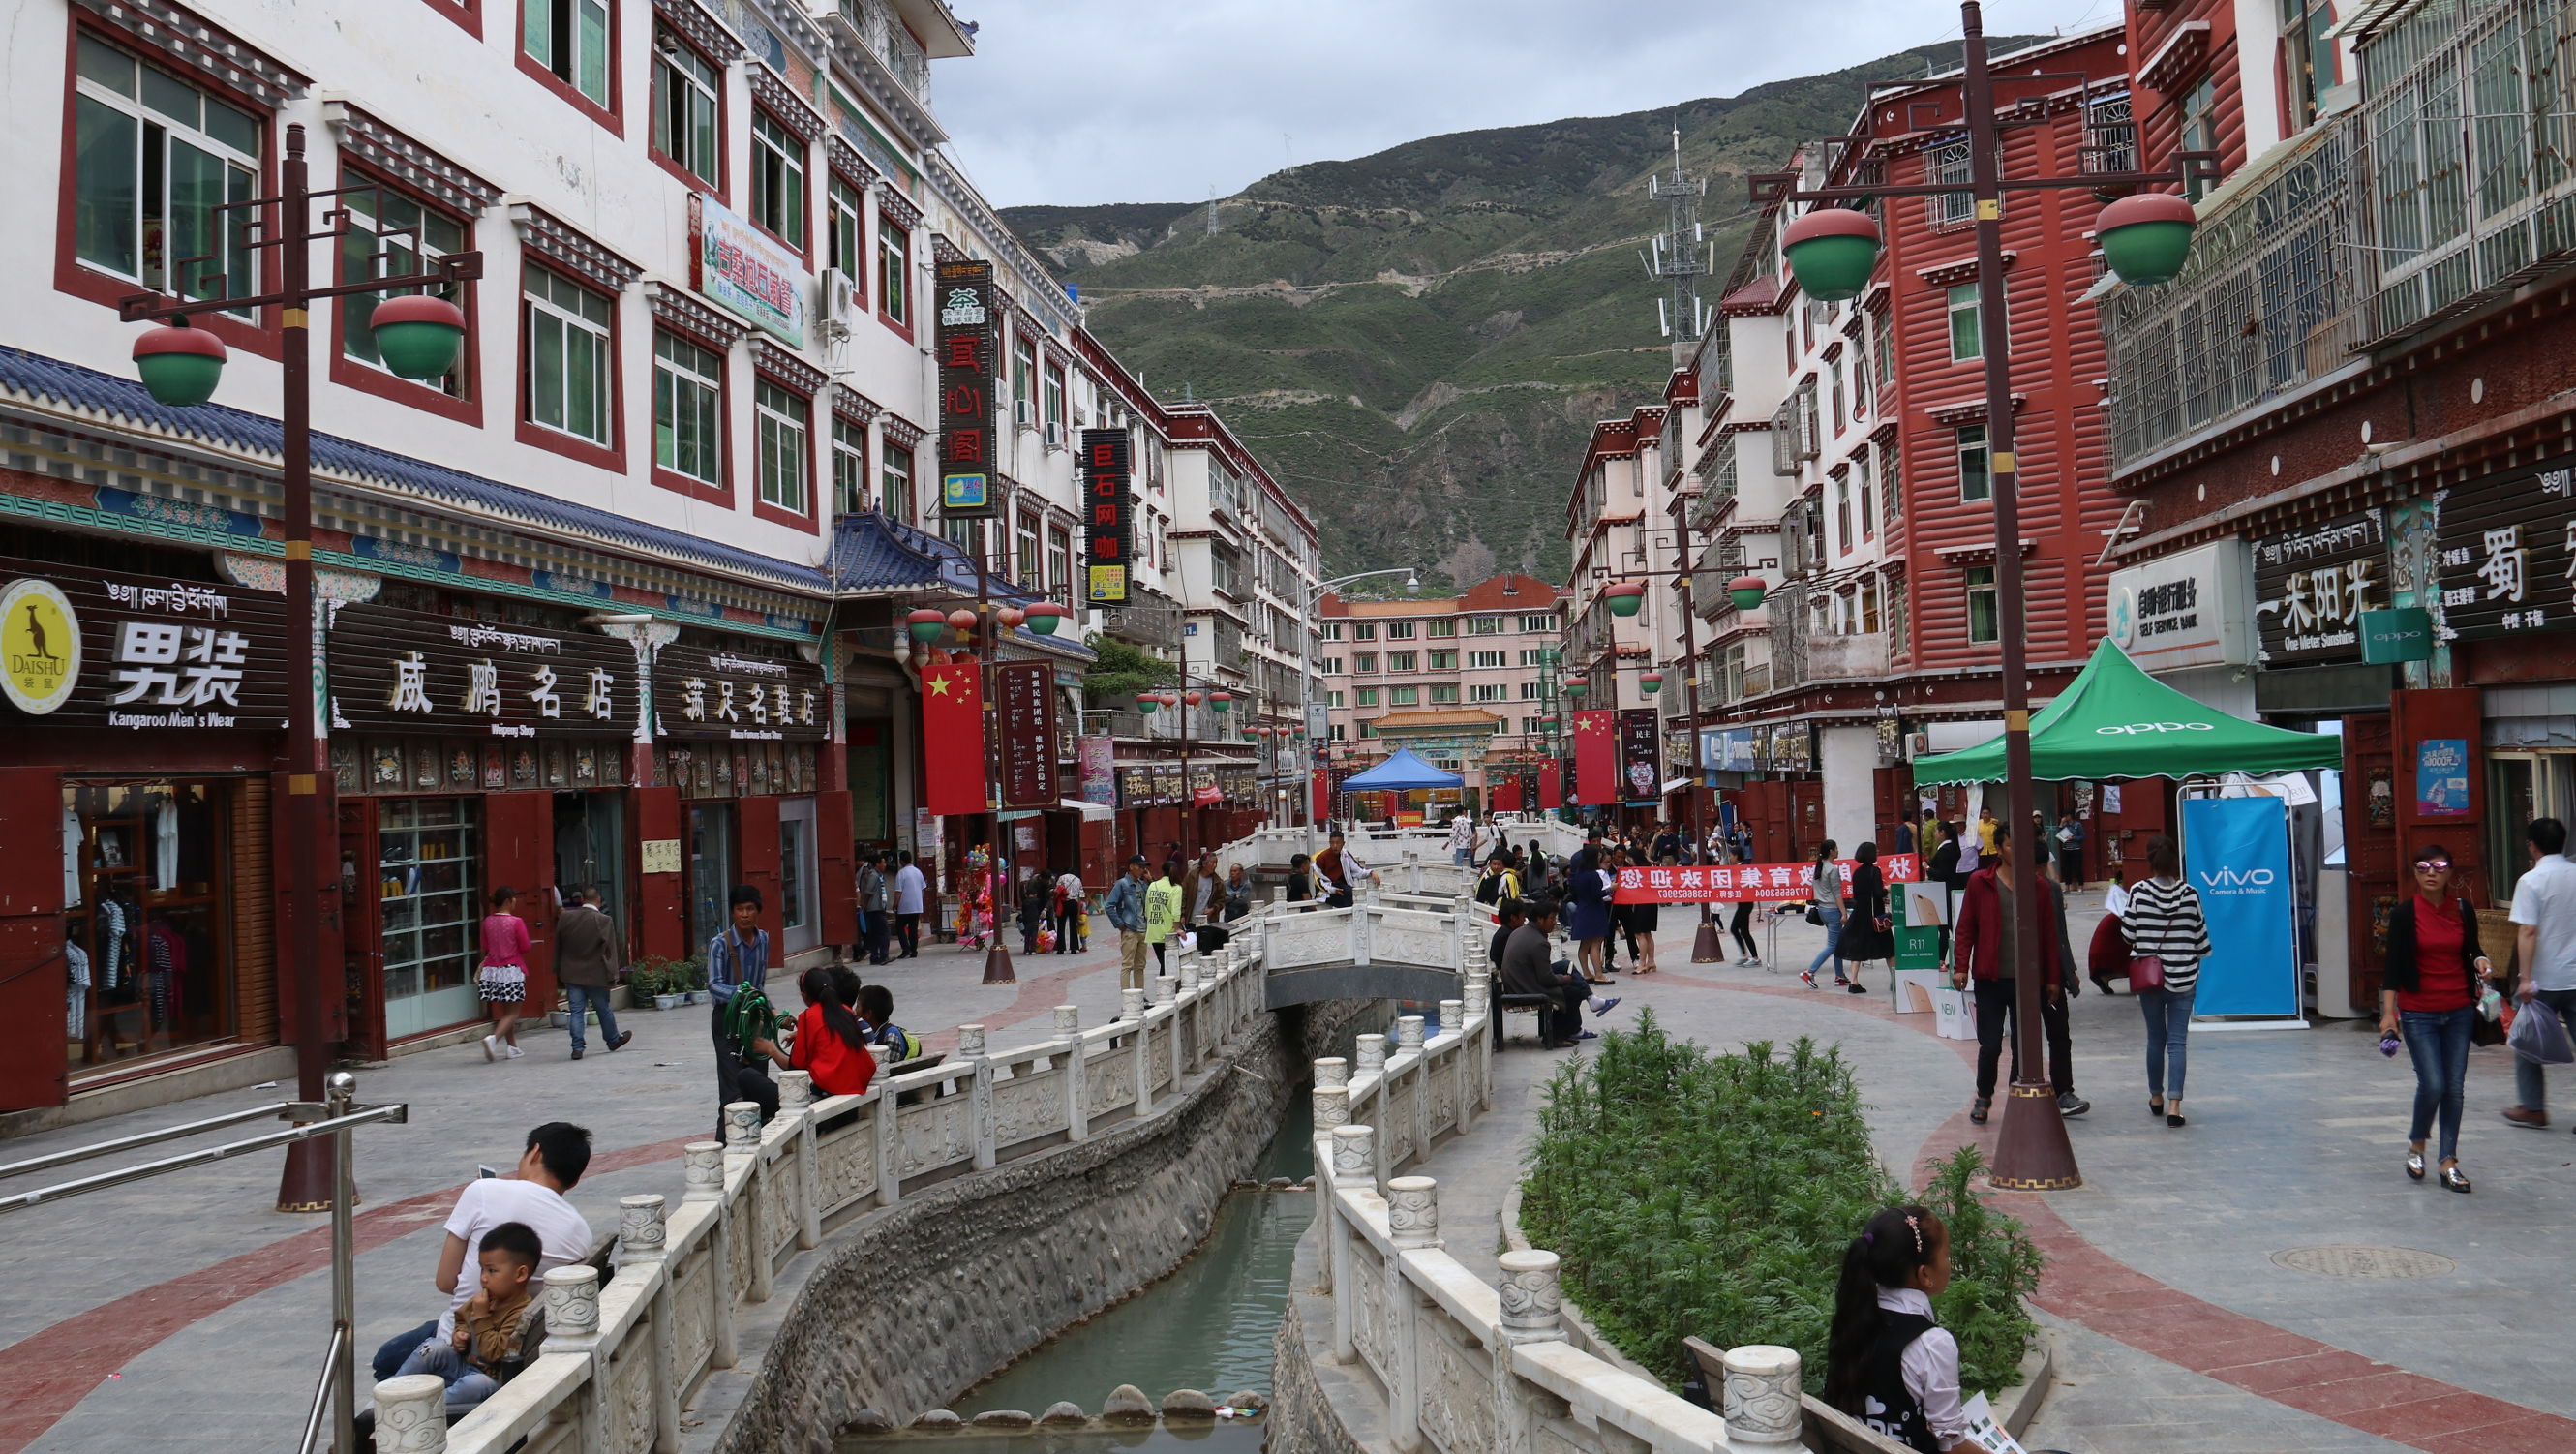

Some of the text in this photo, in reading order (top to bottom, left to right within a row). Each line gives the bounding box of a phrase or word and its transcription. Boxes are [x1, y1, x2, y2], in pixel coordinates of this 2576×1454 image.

[1093, 444, 1119, 559] 巨石网咖
[2477, 525, 2531, 602] 蜀
[2138, 576, 2197, 619] 自助银行服务
[2139, 613, 2198, 637] SELF SERVICE BANK
[2285, 629, 2355, 651] One Meter Sunshine
[106, 620, 250, 707] 男装
[108, 711, 167, 730] Kangaroo
[207, 713, 235, 728] Wear
[519, 725, 535, 738] Shop
[2200, 865, 2274, 886] vivo
[2246, 886, 2266, 894] Music
[1909, 939, 1925, 950] R11
[1942, 1003, 1955, 1015] NEW
